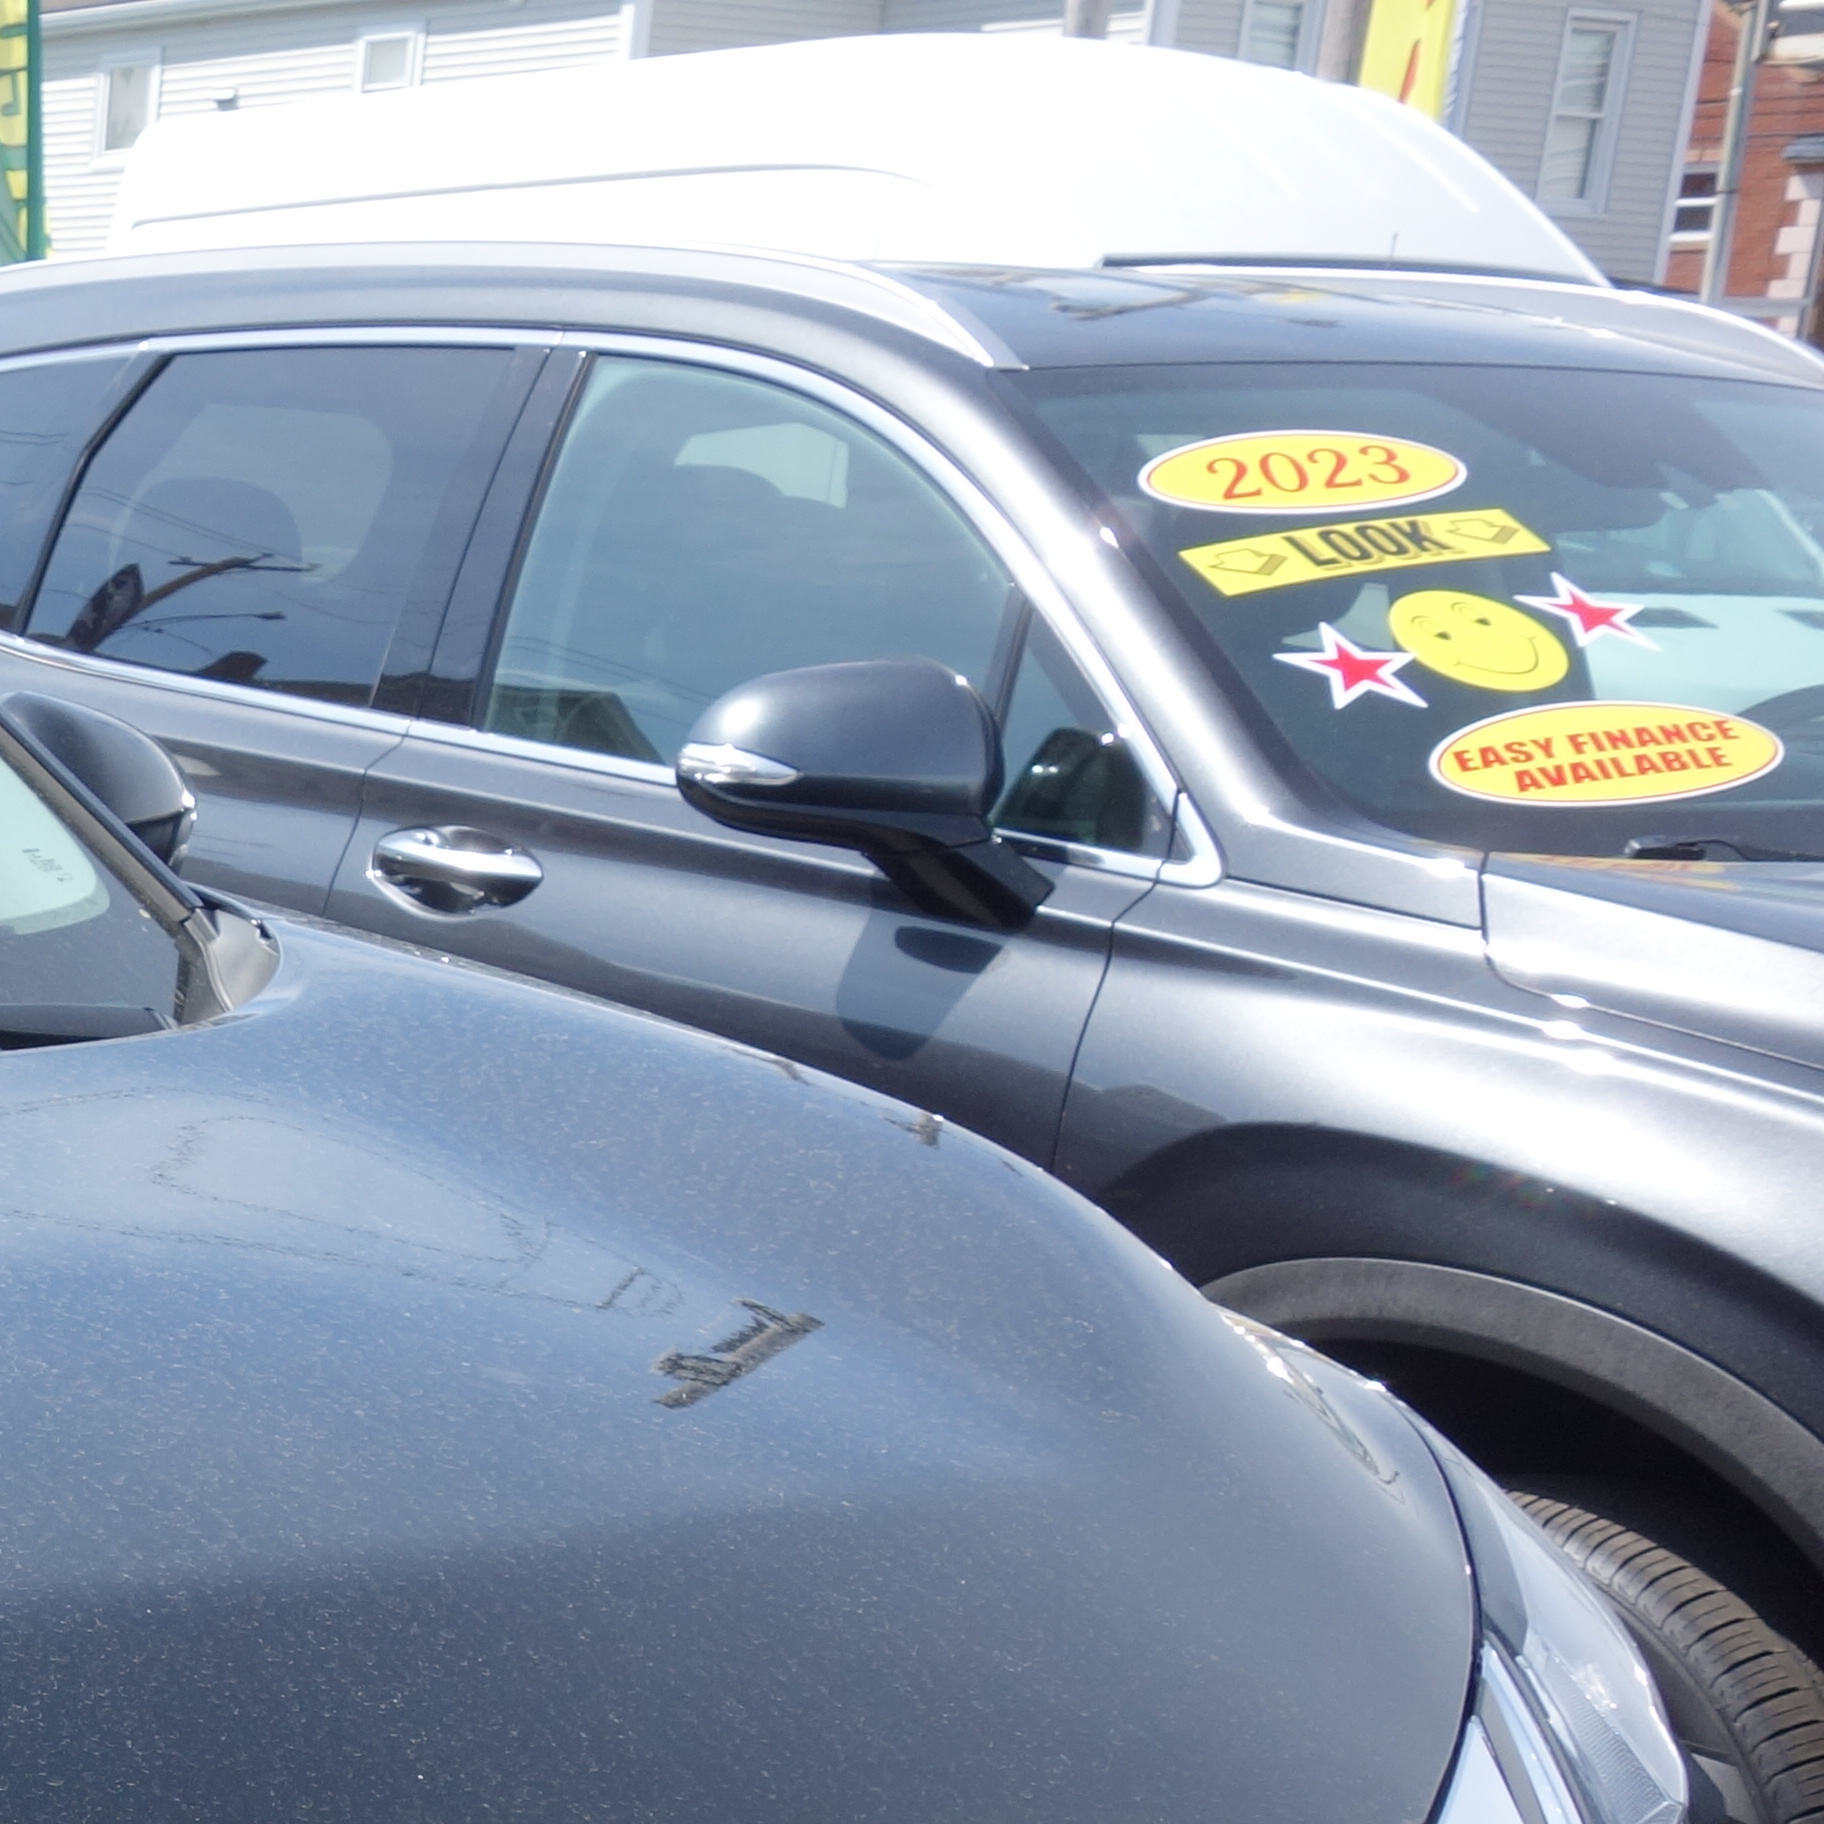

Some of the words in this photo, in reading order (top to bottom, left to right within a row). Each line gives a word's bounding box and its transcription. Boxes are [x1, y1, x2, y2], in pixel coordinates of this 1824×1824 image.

[1206, 445, 1412, 499] 2023
[1283, 519, 1452, 569] LOOK
[1452, 738, 1556, 773] EASY
[1568, 718, 1741, 755] FINANCE
[1514, 747, 1733, 793] AVAILABLE
